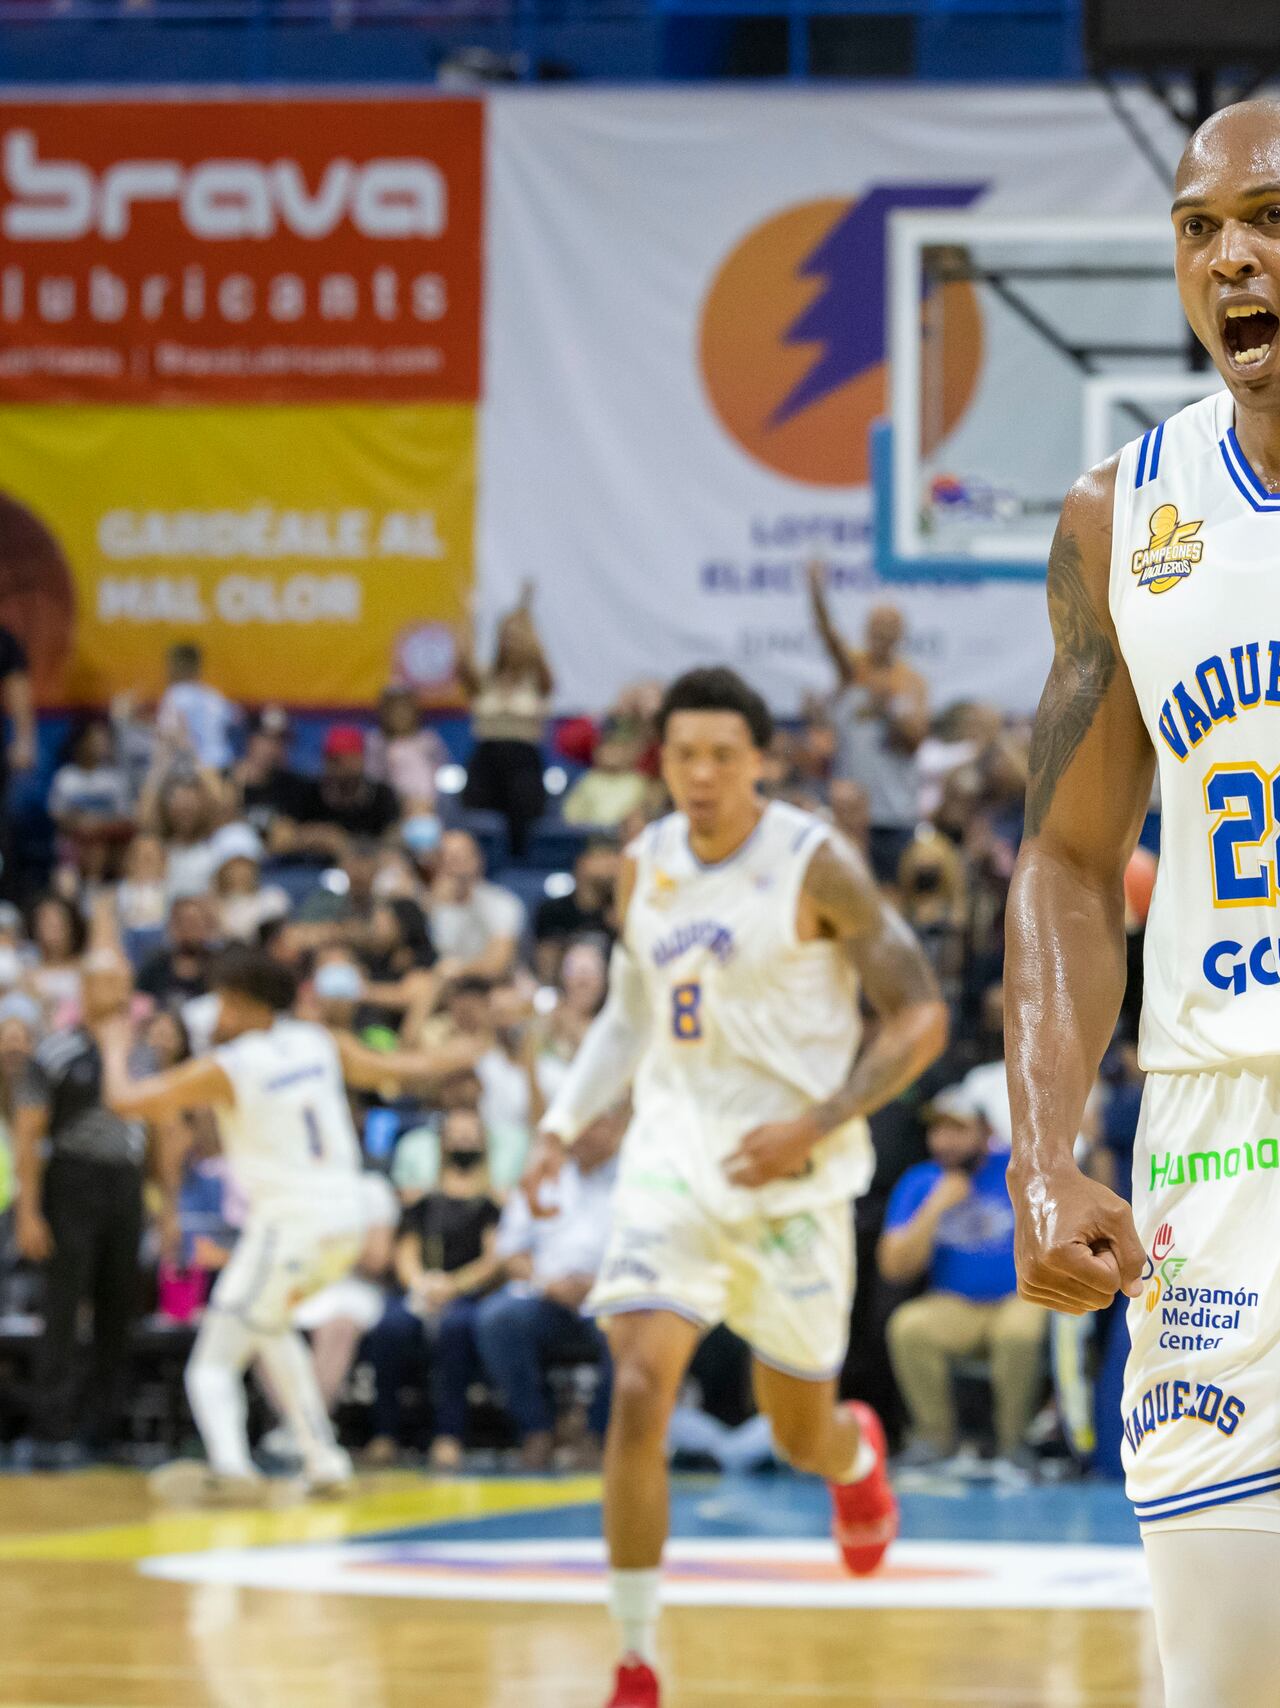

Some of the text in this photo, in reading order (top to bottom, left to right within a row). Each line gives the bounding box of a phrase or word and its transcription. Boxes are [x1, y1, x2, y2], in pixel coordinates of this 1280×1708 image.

[4, 129, 446, 240] brava
[2, 264, 447, 322] lubricants
[380, 510, 444, 559] AL
[1132, 542, 1203, 573] CAMPEONES
[97, 573, 361, 624] MAL OLOR
[671, 978, 703, 1042] 8
[1162, 1285, 1259, 1307] Bayamón
[1162, 1307, 1240, 1329] Medical
[1160, 1331, 1223, 1351] Center
